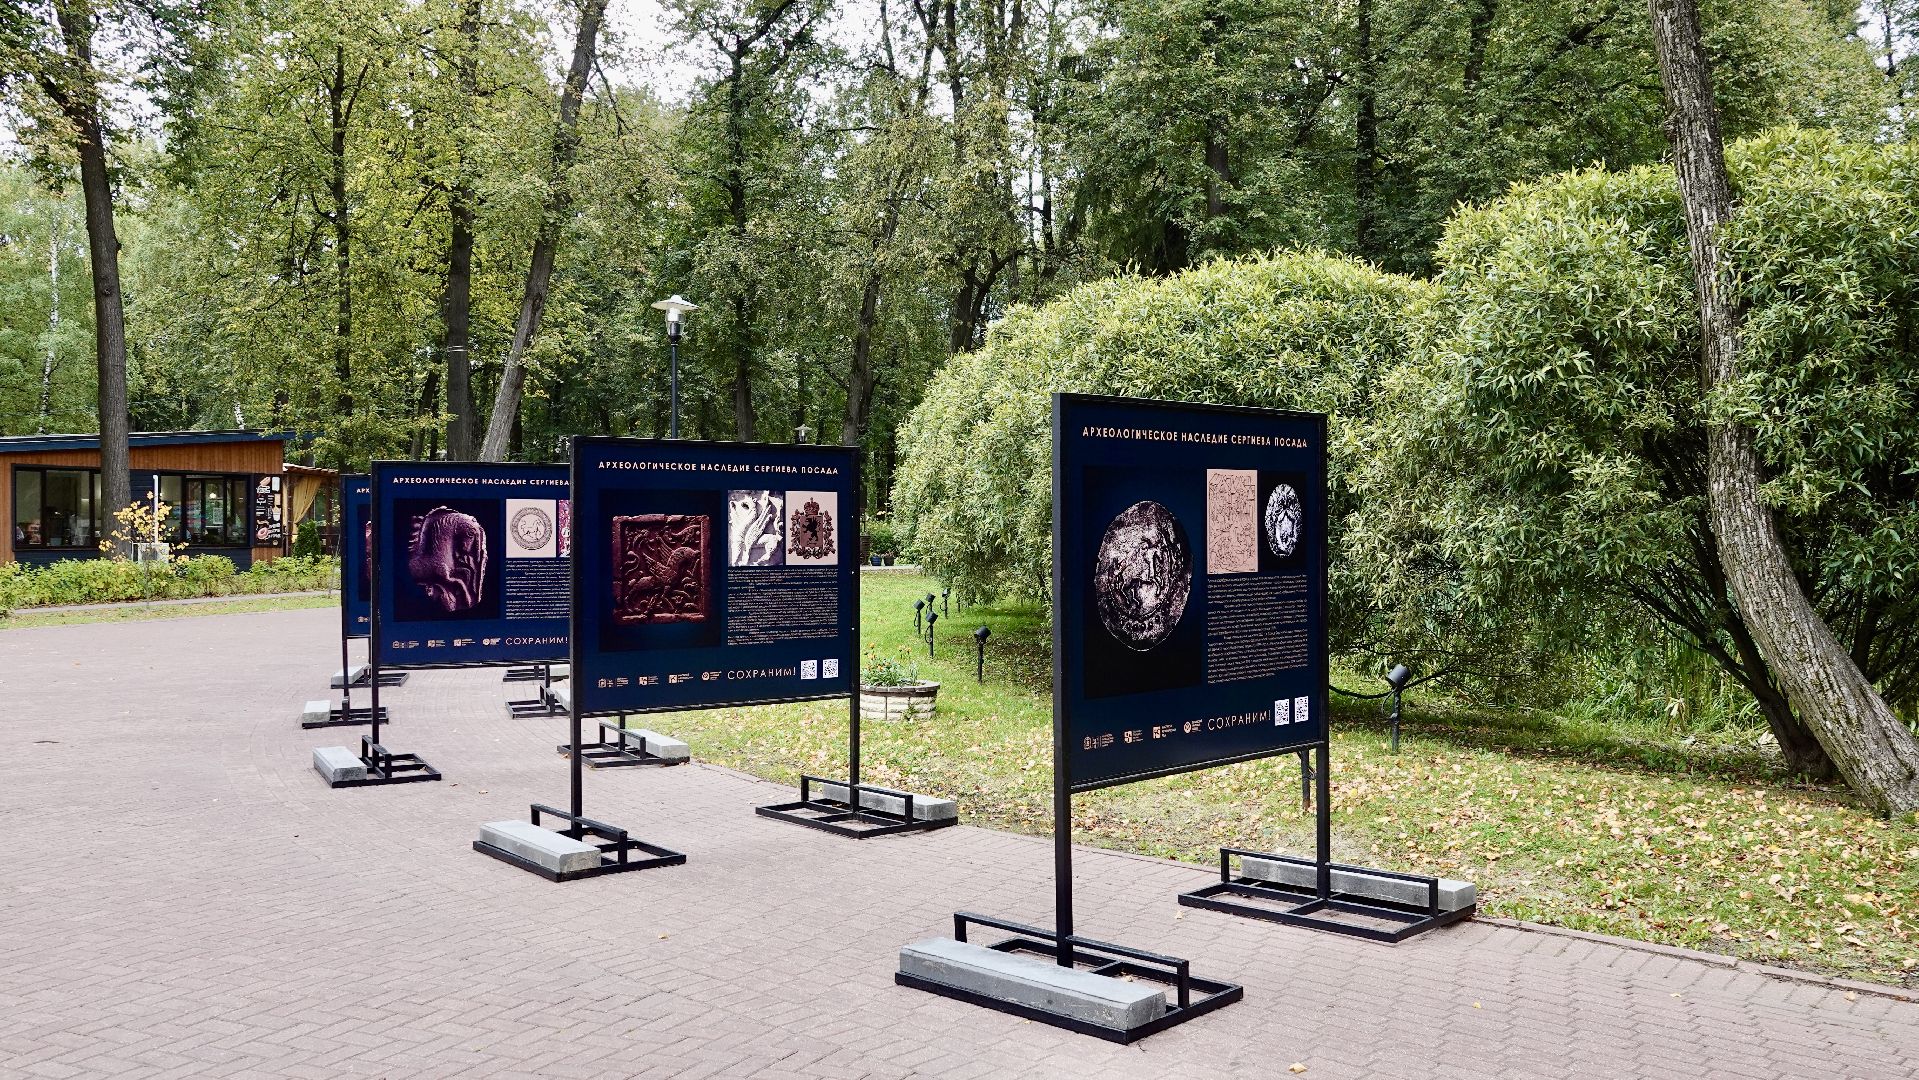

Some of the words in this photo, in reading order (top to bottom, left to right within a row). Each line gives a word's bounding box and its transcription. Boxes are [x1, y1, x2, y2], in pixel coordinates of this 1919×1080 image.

[1082, 426, 1178, 442] АРХЕОЛОГИЧЕСКОЕ
[1181, 432, 1228, 444] НАСЛЕДИЕ
[1230, 434, 1271, 446] СЕРГИЕВА
[1274, 437, 1308, 449] ПОСАДА
[598, 460, 697, 471] АРХЕОЛОГИЧЕСКОЕ
[700, 463, 750, 473] НАСЛЕДИЕ
[753, 464, 798, 474] СЕРГИЕВА
[801, 466, 839, 475] ПОСАДА
[392, 477, 479, 485] АРХЕОЛОГИЧЕСКОЕ
[481, 478, 527, 486] НАСЛЕДИЕ
[529, 479, 570, 487] СЕРГИЕВА
[505, 637, 569, 646] СОХРАНИМ!
[727, 667, 797, 681] СОХРАНИМ!
[1208, 710, 1271, 731] СОХРАНИМ!
